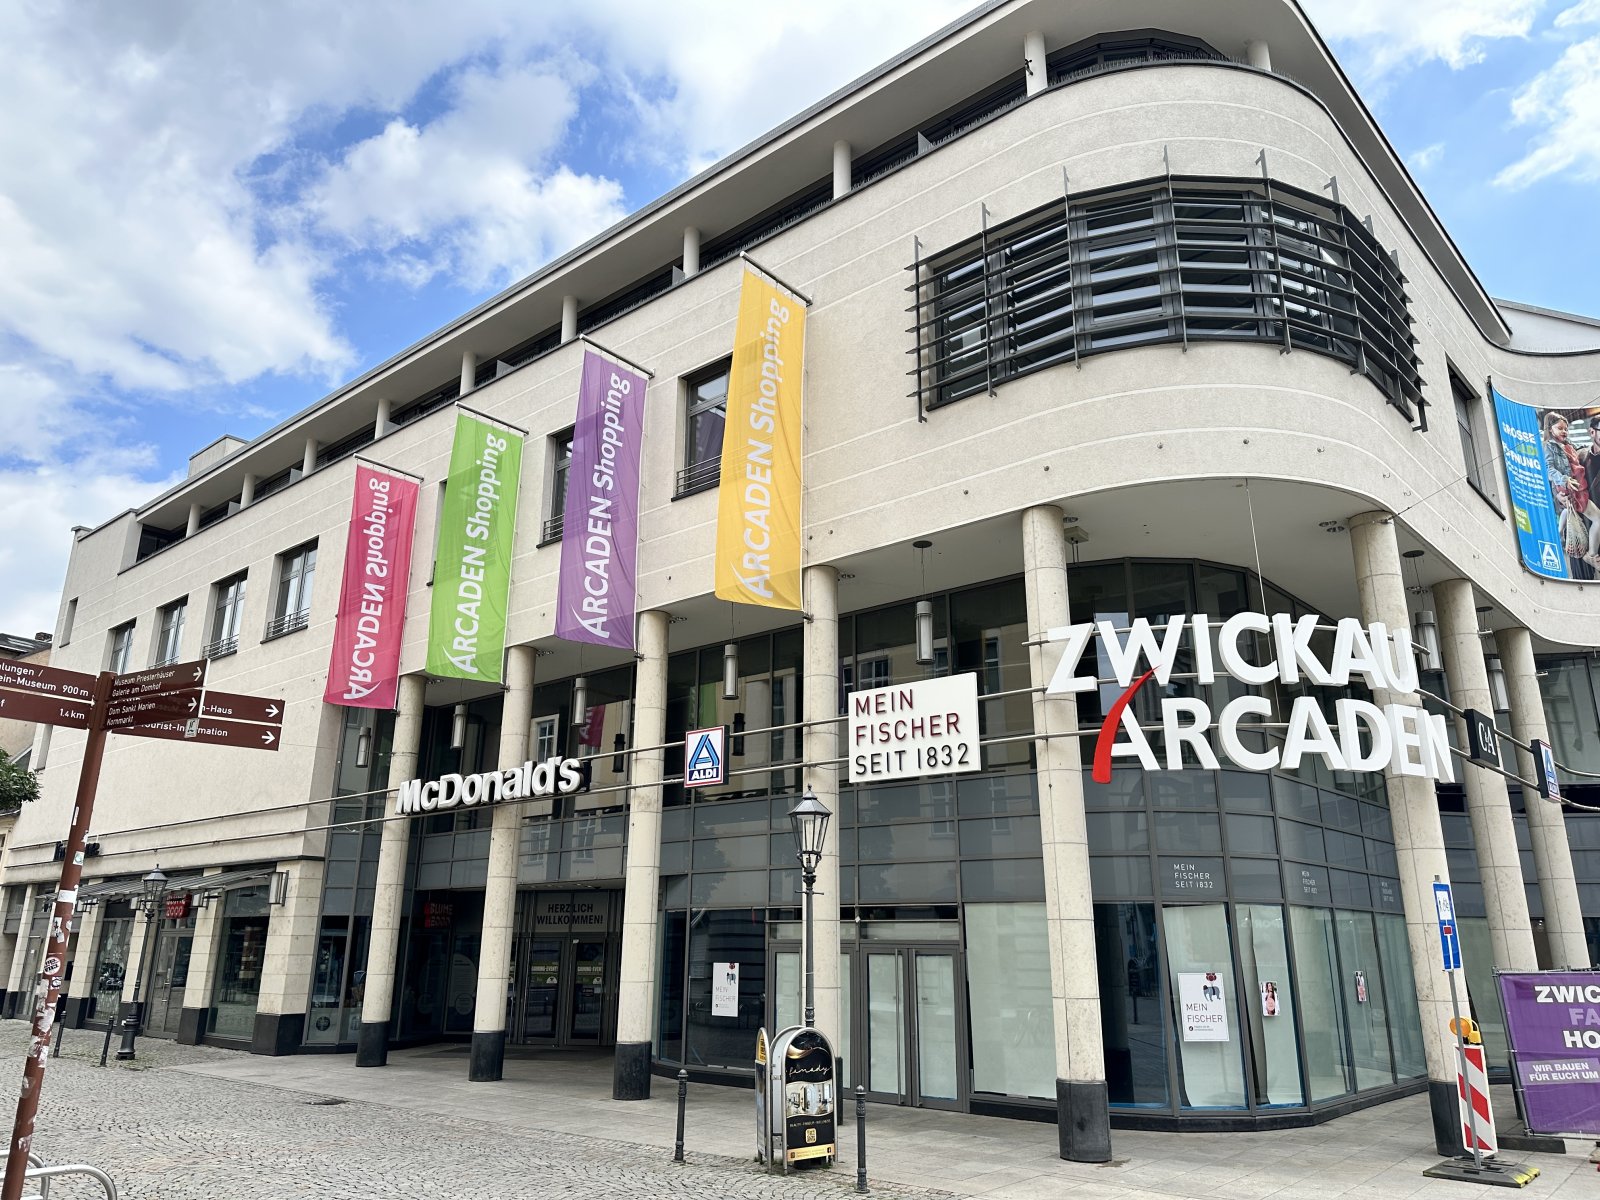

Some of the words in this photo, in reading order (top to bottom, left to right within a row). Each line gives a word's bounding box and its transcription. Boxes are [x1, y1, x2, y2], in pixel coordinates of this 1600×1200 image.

[750, 298, 790, 434] Shopping
[570, 496, 612, 639] ARCADEN
[592, 372, 631, 491] Shopping
[729, 439, 774, 599] ARCADEN
[442, 545, 487, 675] ARCADEN
[466, 432, 509, 542] Shopping
[1045, 611, 1420, 695] ZWICKAU
[114, 674, 136, 686] Museum
[62, 684, 79, 695] 900
[80, 689, 89, 697] m
[111, 686, 131, 697] Galerie
[131, 684, 140, 694] am
[140, 681, 162, 692] Domhof
[108, 705, 120, 716] Dom
[121, 702, 137, 713] Sankt
[137, 700, 156, 712] Marien
[855, 688, 914, 717] MEIN
[60, 708, 69, 718] 1.4
[70, 710, 85, 720] km
[855, 712, 961, 746] FISCHER
[1091, 665, 1456, 784] ARCADEN
[855, 750, 907, 775] SEIT
[917, 742, 970, 769] 1832
[691, 767, 717, 781] ALDI
[395, 756, 582, 814] McDonald's
[1173, 863, 1195, 871] MEIN
[1174, 872, 1210, 880] FISCHER
[1175, 881, 1194, 889] SEIT
[1196, 881, 1213, 889] 1832
[547, 903, 594, 913] HERZLICH
[536, 915, 604, 925] WILLKOMMEN!
[1534, 985, 1600, 1003] ZWIC
[1185, 1003, 1208, 1011] MEIN
[1186, 1014, 1223, 1023] FISCHER
[1569, 1008, 1600, 1026] FA
[1563, 1030, 1600, 1049] HO
[1532, 1063, 1553, 1073] WIR
[1555, 1061, 1590, 1072] BAUEN
[1529, 1071, 1551, 1082] FÜR
[1552, 1071, 1580, 1081] EUCH
[1582, 1070, 1599, 1079] UM
